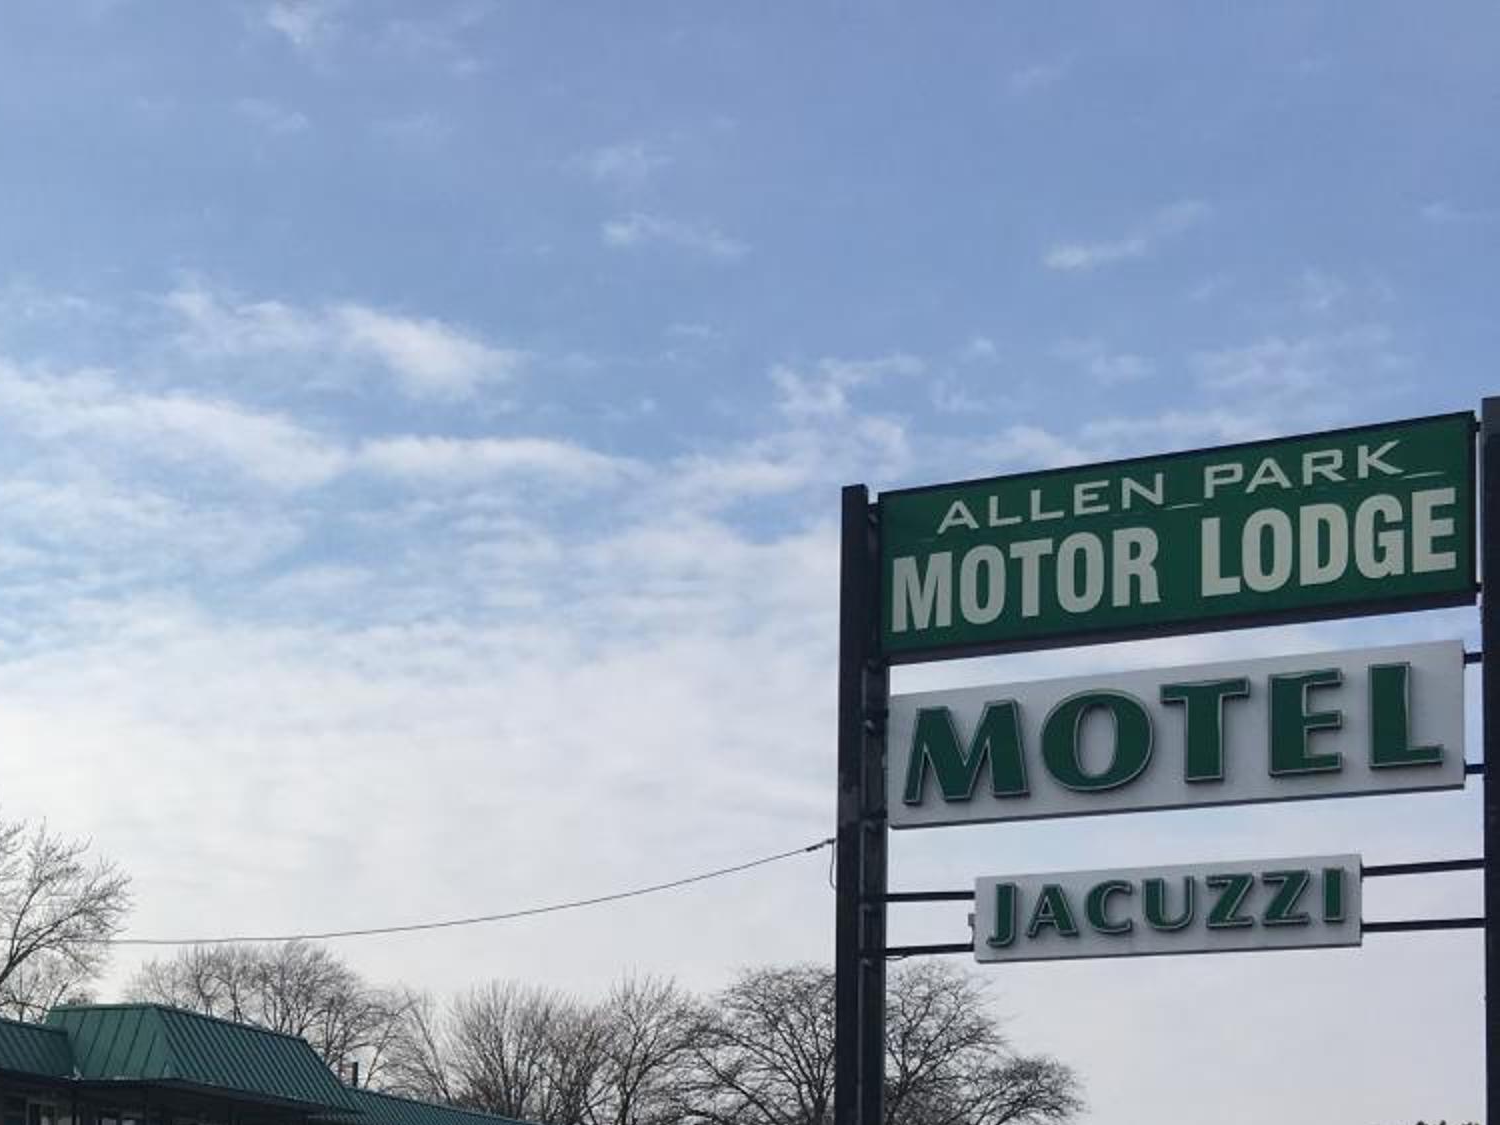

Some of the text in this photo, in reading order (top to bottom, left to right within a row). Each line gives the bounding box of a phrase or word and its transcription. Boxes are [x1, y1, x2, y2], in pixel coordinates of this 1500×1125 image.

[936, 440, 1404, 534] ALLEN PARK
[891, 487, 1457, 633] MOTOR LODGE
[902, 661, 1445, 806] MOTEL
[986, 866, 1347, 948] JACUZZI
